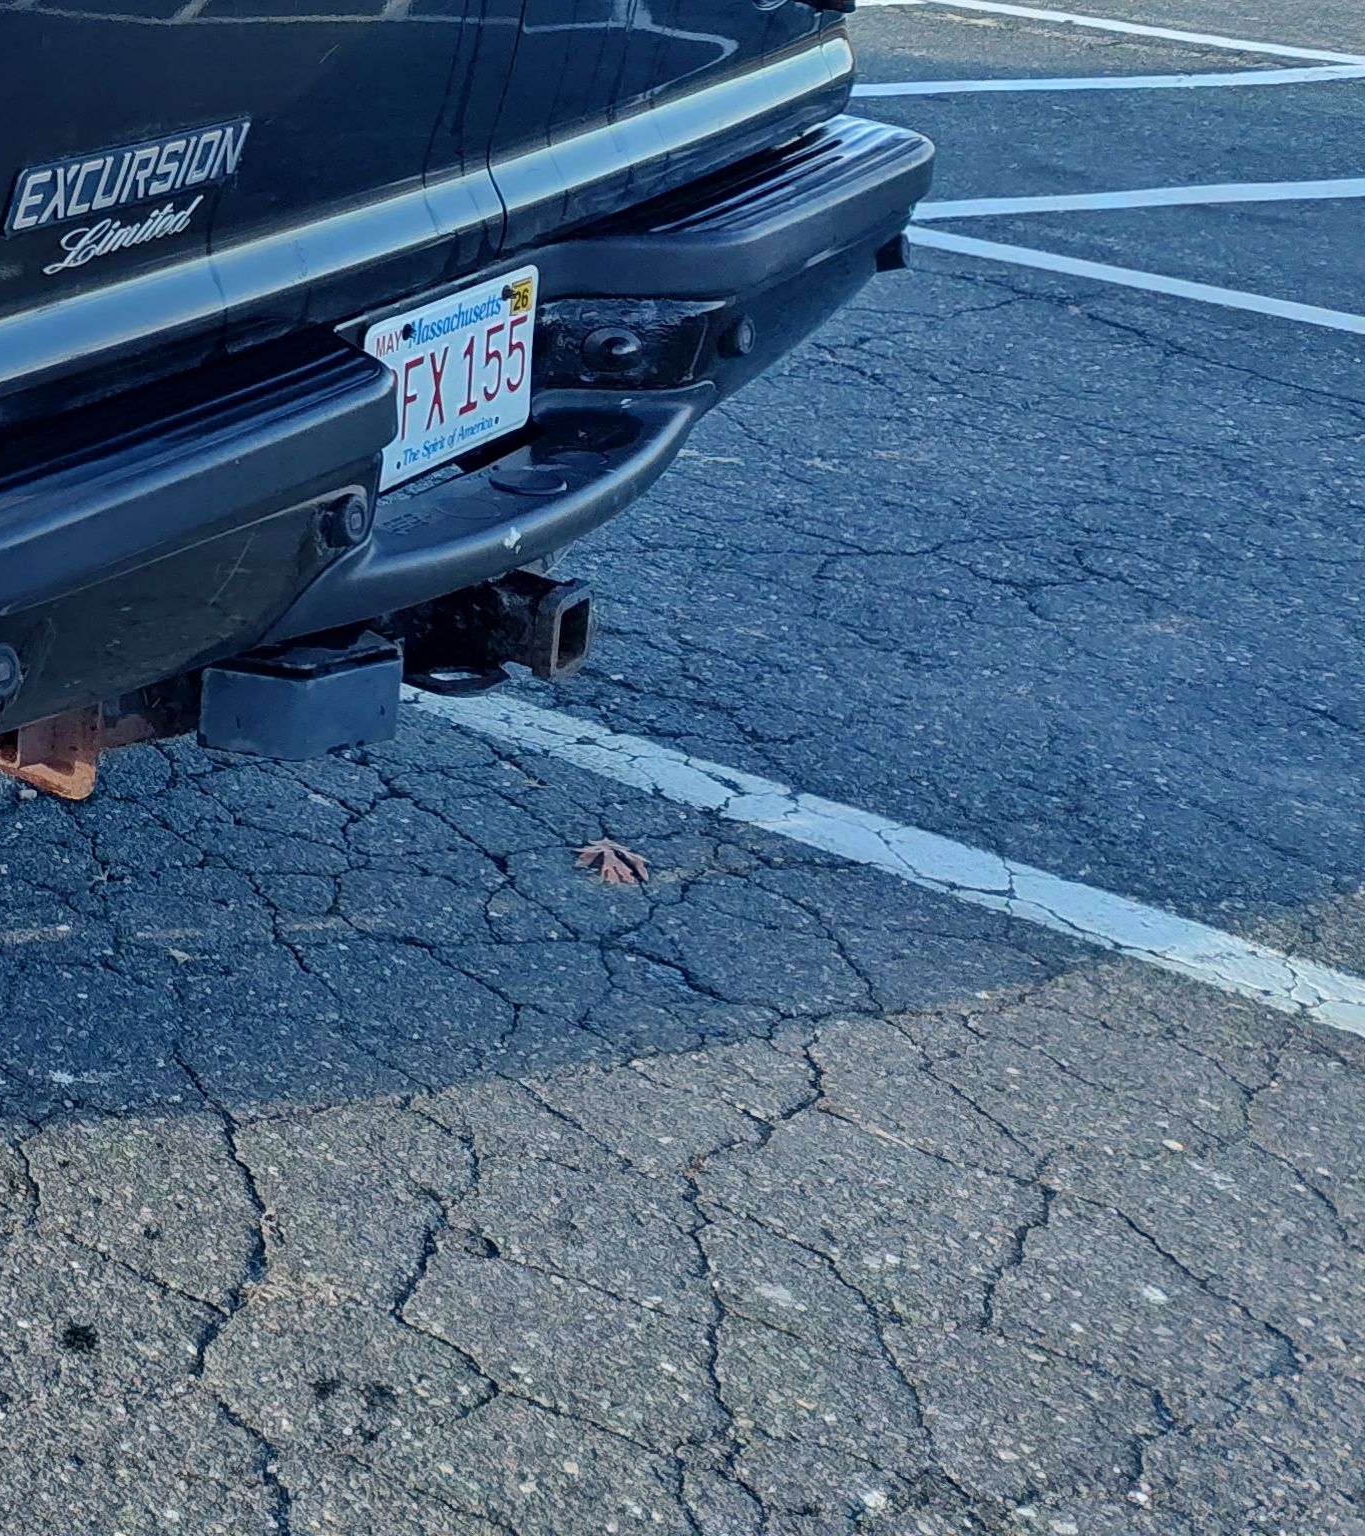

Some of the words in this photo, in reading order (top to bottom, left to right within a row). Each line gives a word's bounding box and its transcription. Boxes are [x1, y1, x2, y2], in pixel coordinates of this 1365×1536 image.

[12, 122, 250, 231] EXCURSION
[43, 195, 204, 275] Limited
[408, 295, 502, 349] Massachusetts
[513, 288, 529, 312] 26
[376, 330, 403, 358] MAY
[390, 351, 449, 441] FX
[459, 315, 528, 416] 155
[403, 446, 420, 466] The
[422, 435, 446, 459] Spirit
[447, 428, 457, 449] of
[457, 417, 493, 442] America
